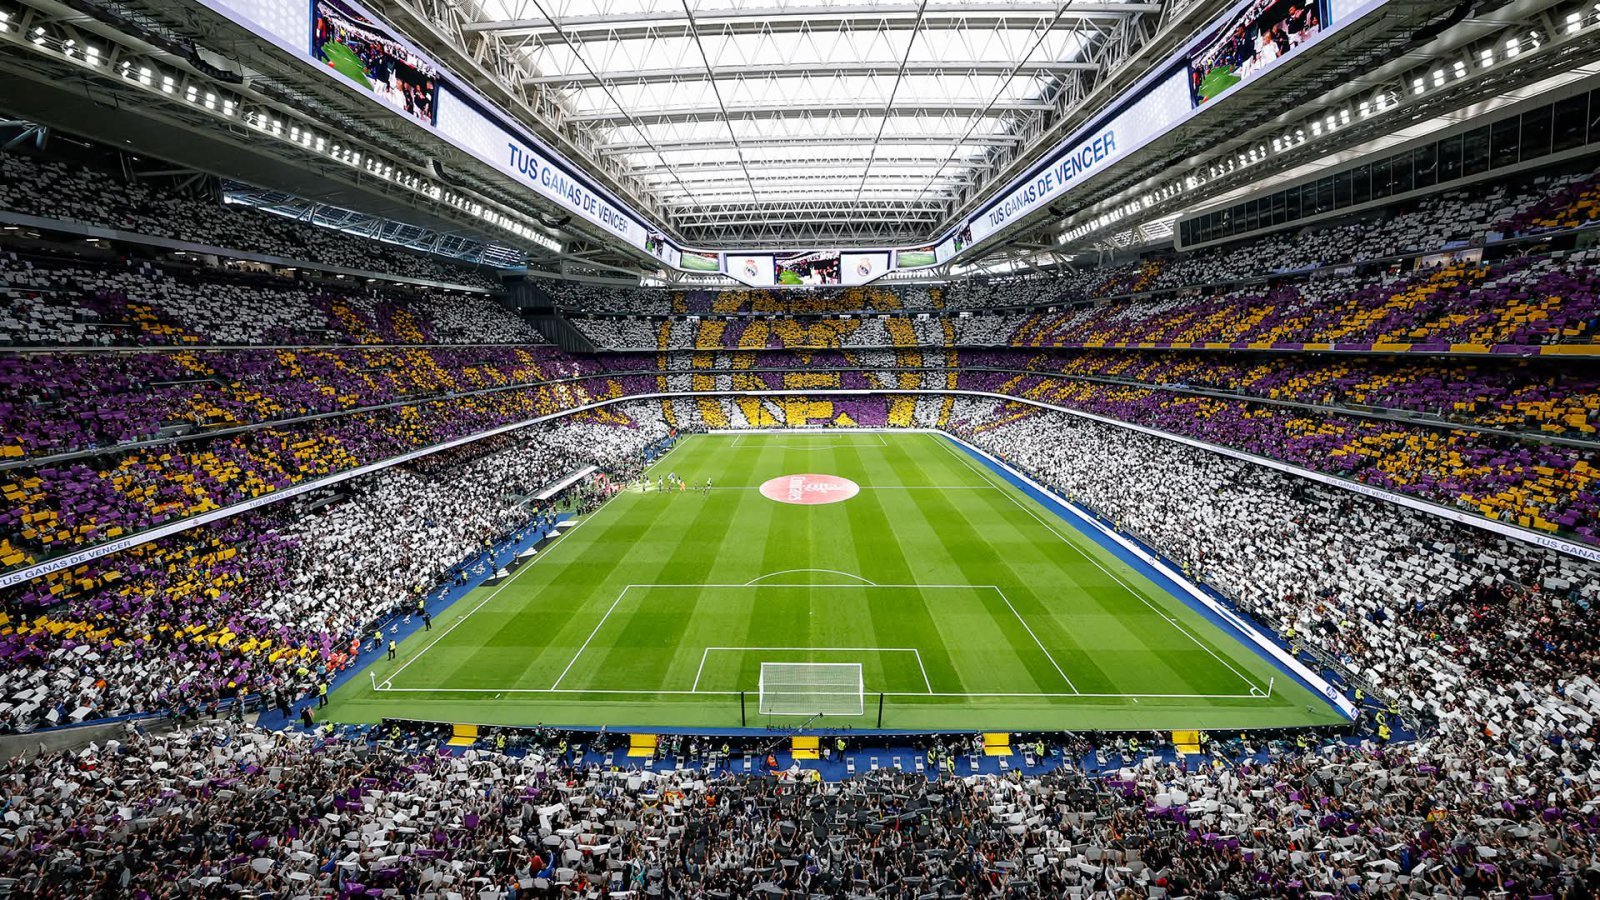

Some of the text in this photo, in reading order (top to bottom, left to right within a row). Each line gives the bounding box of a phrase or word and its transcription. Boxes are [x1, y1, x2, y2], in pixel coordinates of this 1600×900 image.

[508, 143, 628, 233] TUS GANAS DE VENCER
[988, 130, 1116, 227] TUS GANAS DE VENCER
[1339, 480, 1360, 492] GANAS
[1372, 490, 1400, 502] VENCER
[1535, 537, 1557, 549] TUS
[0, 540, 131, 585] US GANAS DE VENCER
[1326, 686, 1337, 700] hp
